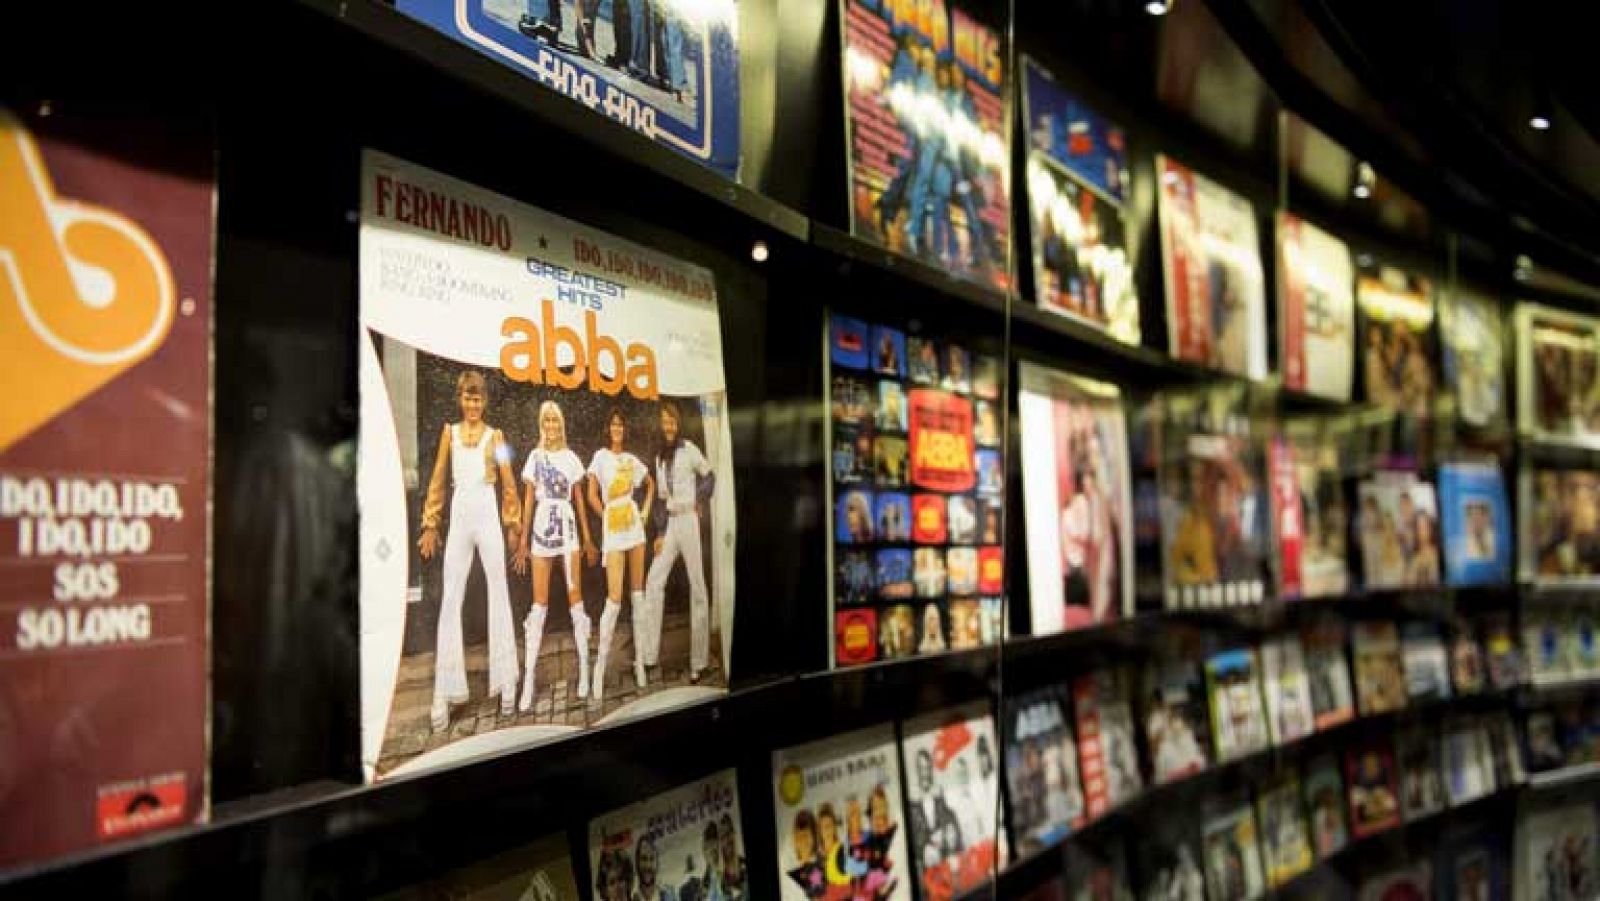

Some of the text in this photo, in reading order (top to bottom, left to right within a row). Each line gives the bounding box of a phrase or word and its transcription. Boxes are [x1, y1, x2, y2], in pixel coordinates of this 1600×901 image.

[375, 174, 512, 252] FERNANDO
[526, 258, 627, 299] GREATEST
[557, 284, 604, 312] HITS
[500, 299, 660, 401] abba
[53, 561, 120, 602] SOS
[16, 602, 152, 651] SO LONG
